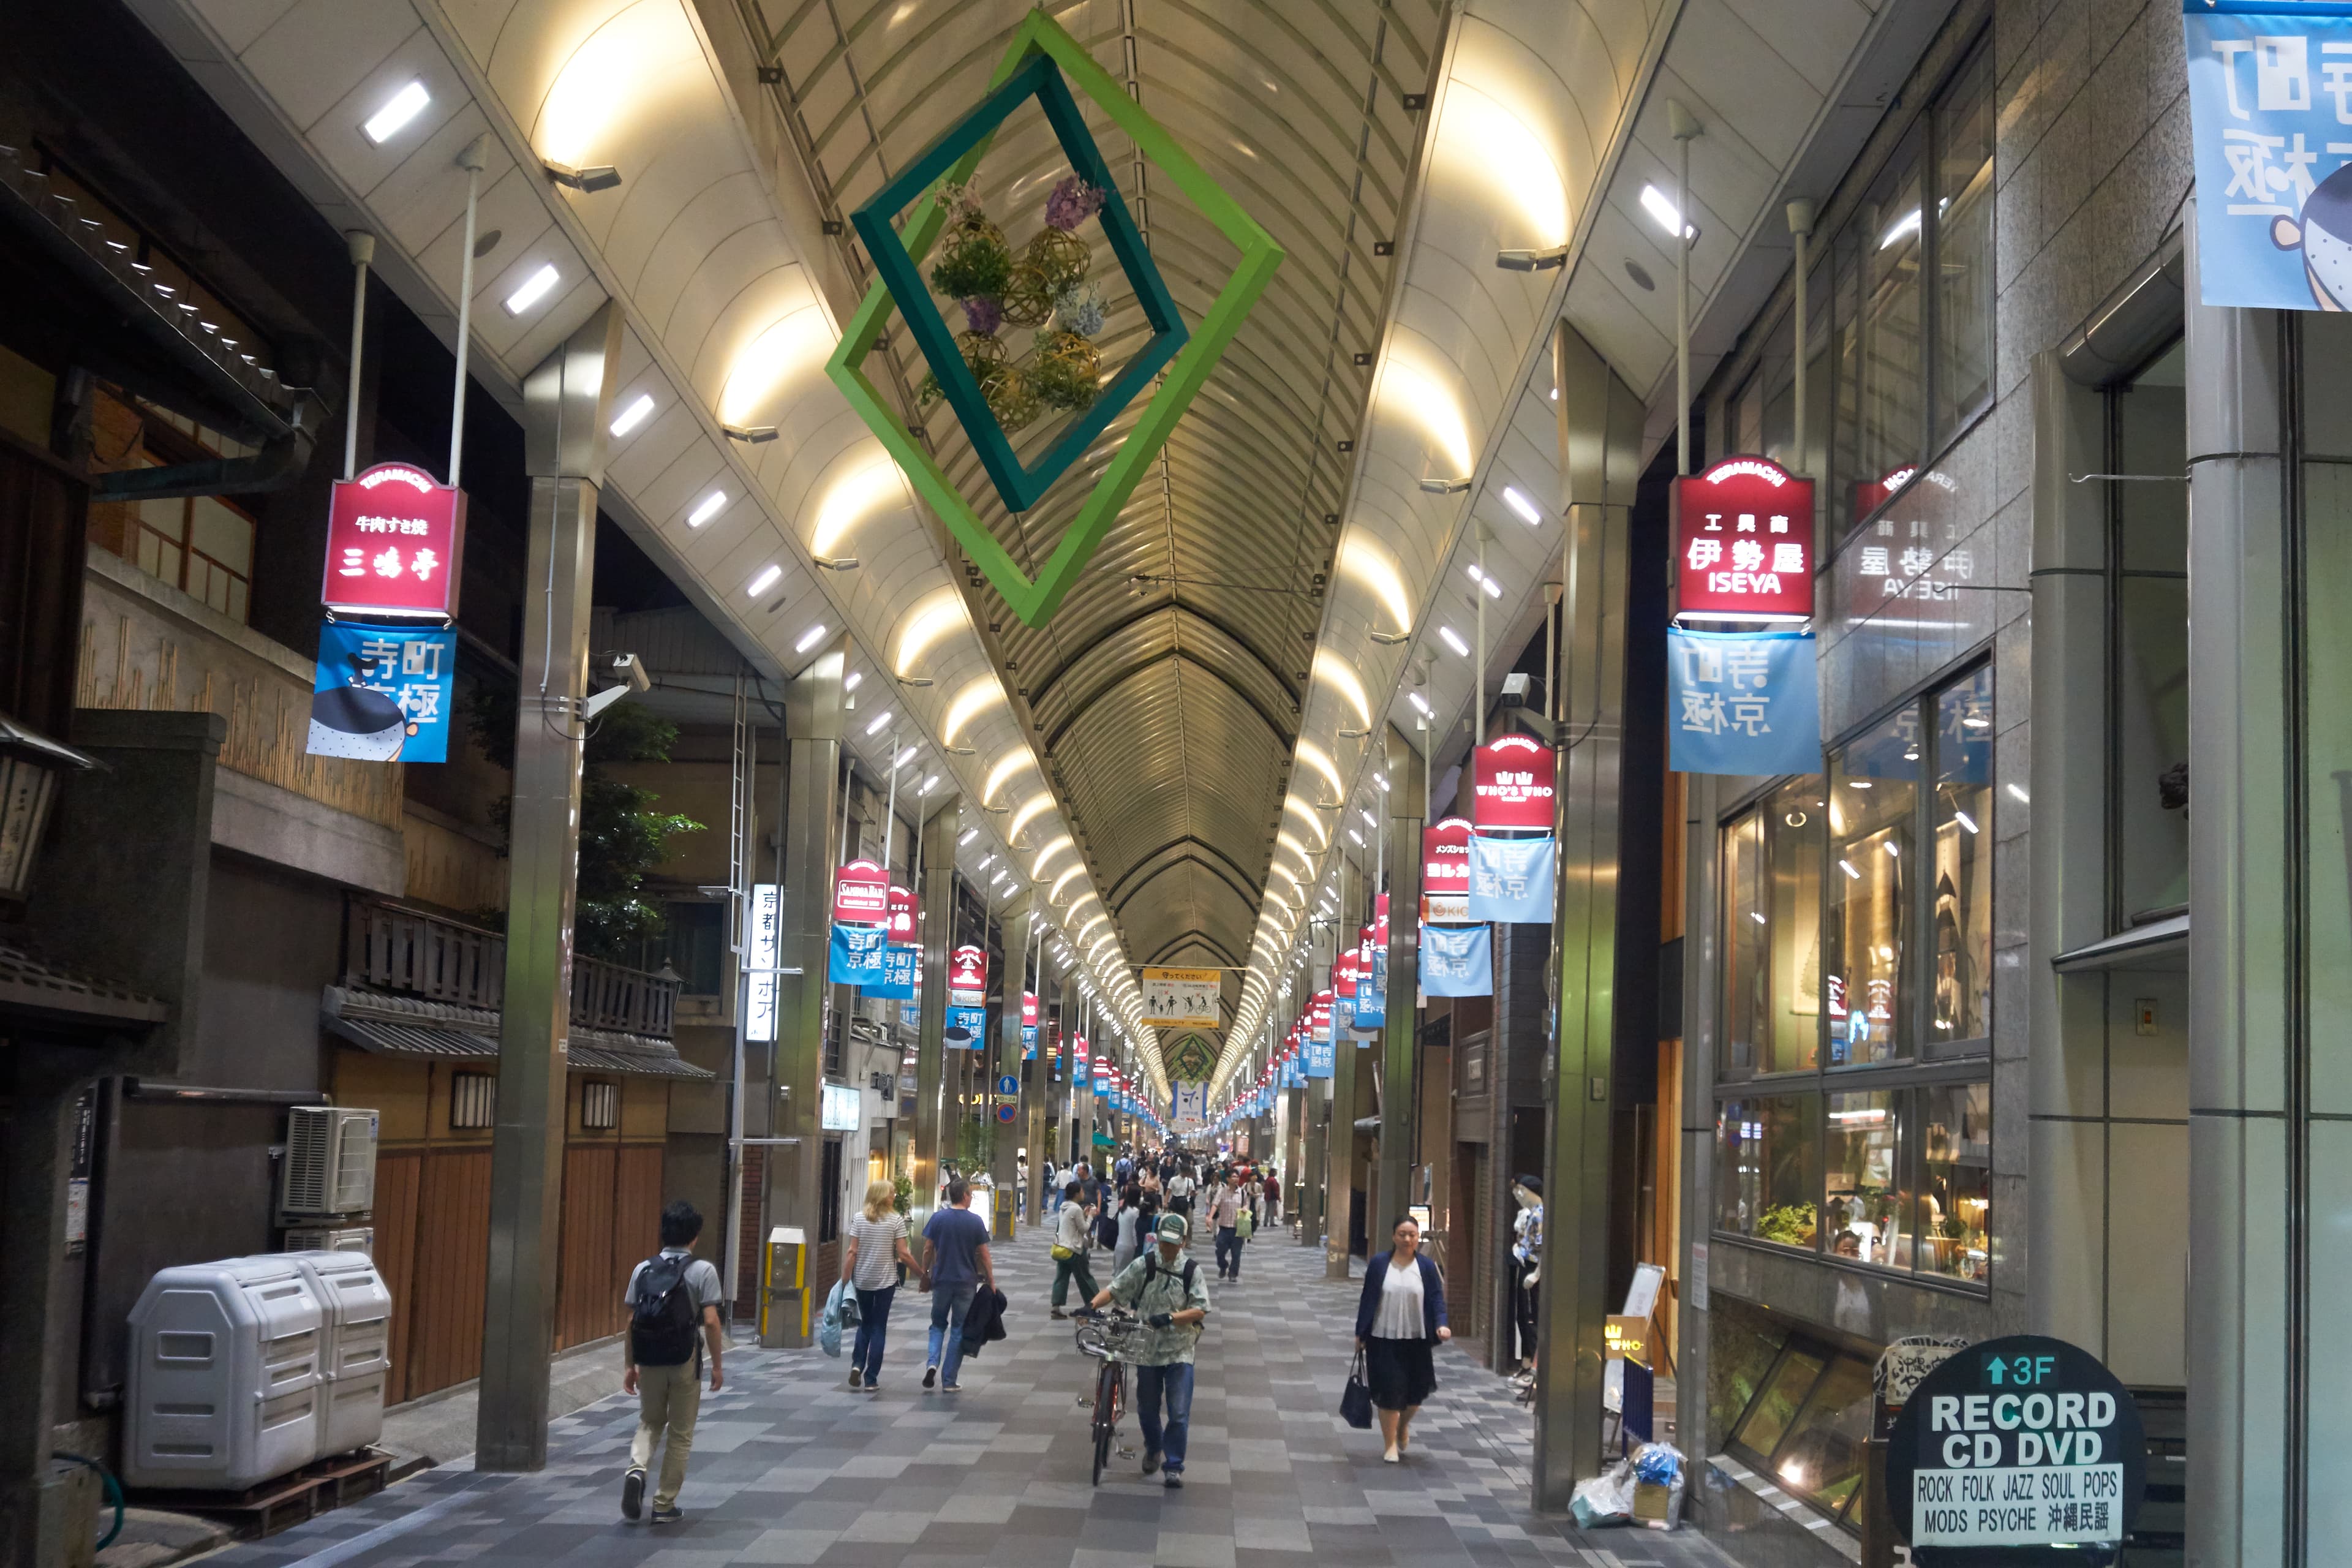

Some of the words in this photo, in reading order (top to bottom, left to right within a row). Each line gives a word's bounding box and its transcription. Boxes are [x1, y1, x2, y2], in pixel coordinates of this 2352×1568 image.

[360, 469, 432, 492] TERAMACHI
[1706, 462, 1787, 488] TERAMACHI
[355, 516, 428, 535] 牛肉すき焼
[1705, 514, 1789, 533] 工具商
[1687, 538, 1804, 574] 伊勢屋
[1709, 573, 1782, 594] ISEYA
[360, 639, 445, 680] 寺町
[1476, 785, 1518, 796] WHO'S
[1521, 786, 1553, 797] WHO
[848, 933, 884, 950] 寺町
[846, 951, 882, 970] 京極
[2013, 1356, 2055, 1385] 3F
[1931, 1392, 2116, 1431] RECORD
[1942, 1433, 2002, 1468] CD
[2018, 1431, 2103, 1466] DVD
[1918, 1476, 1953, 1502] ROCK
[1962, 1475, 1994, 1502] FOLK
[2003, 1474, 2034, 1501] JAZZ
[2042, 1472, 2075, 1499] SOUL
[2083, 1471, 2117, 1498] POPS
[1924, 1509, 1967, 1533] MODS
[1978, 1507, 2036, 1532] PSYCHE
[2048, 1502, 2109, 1532] 沖縄民謡
